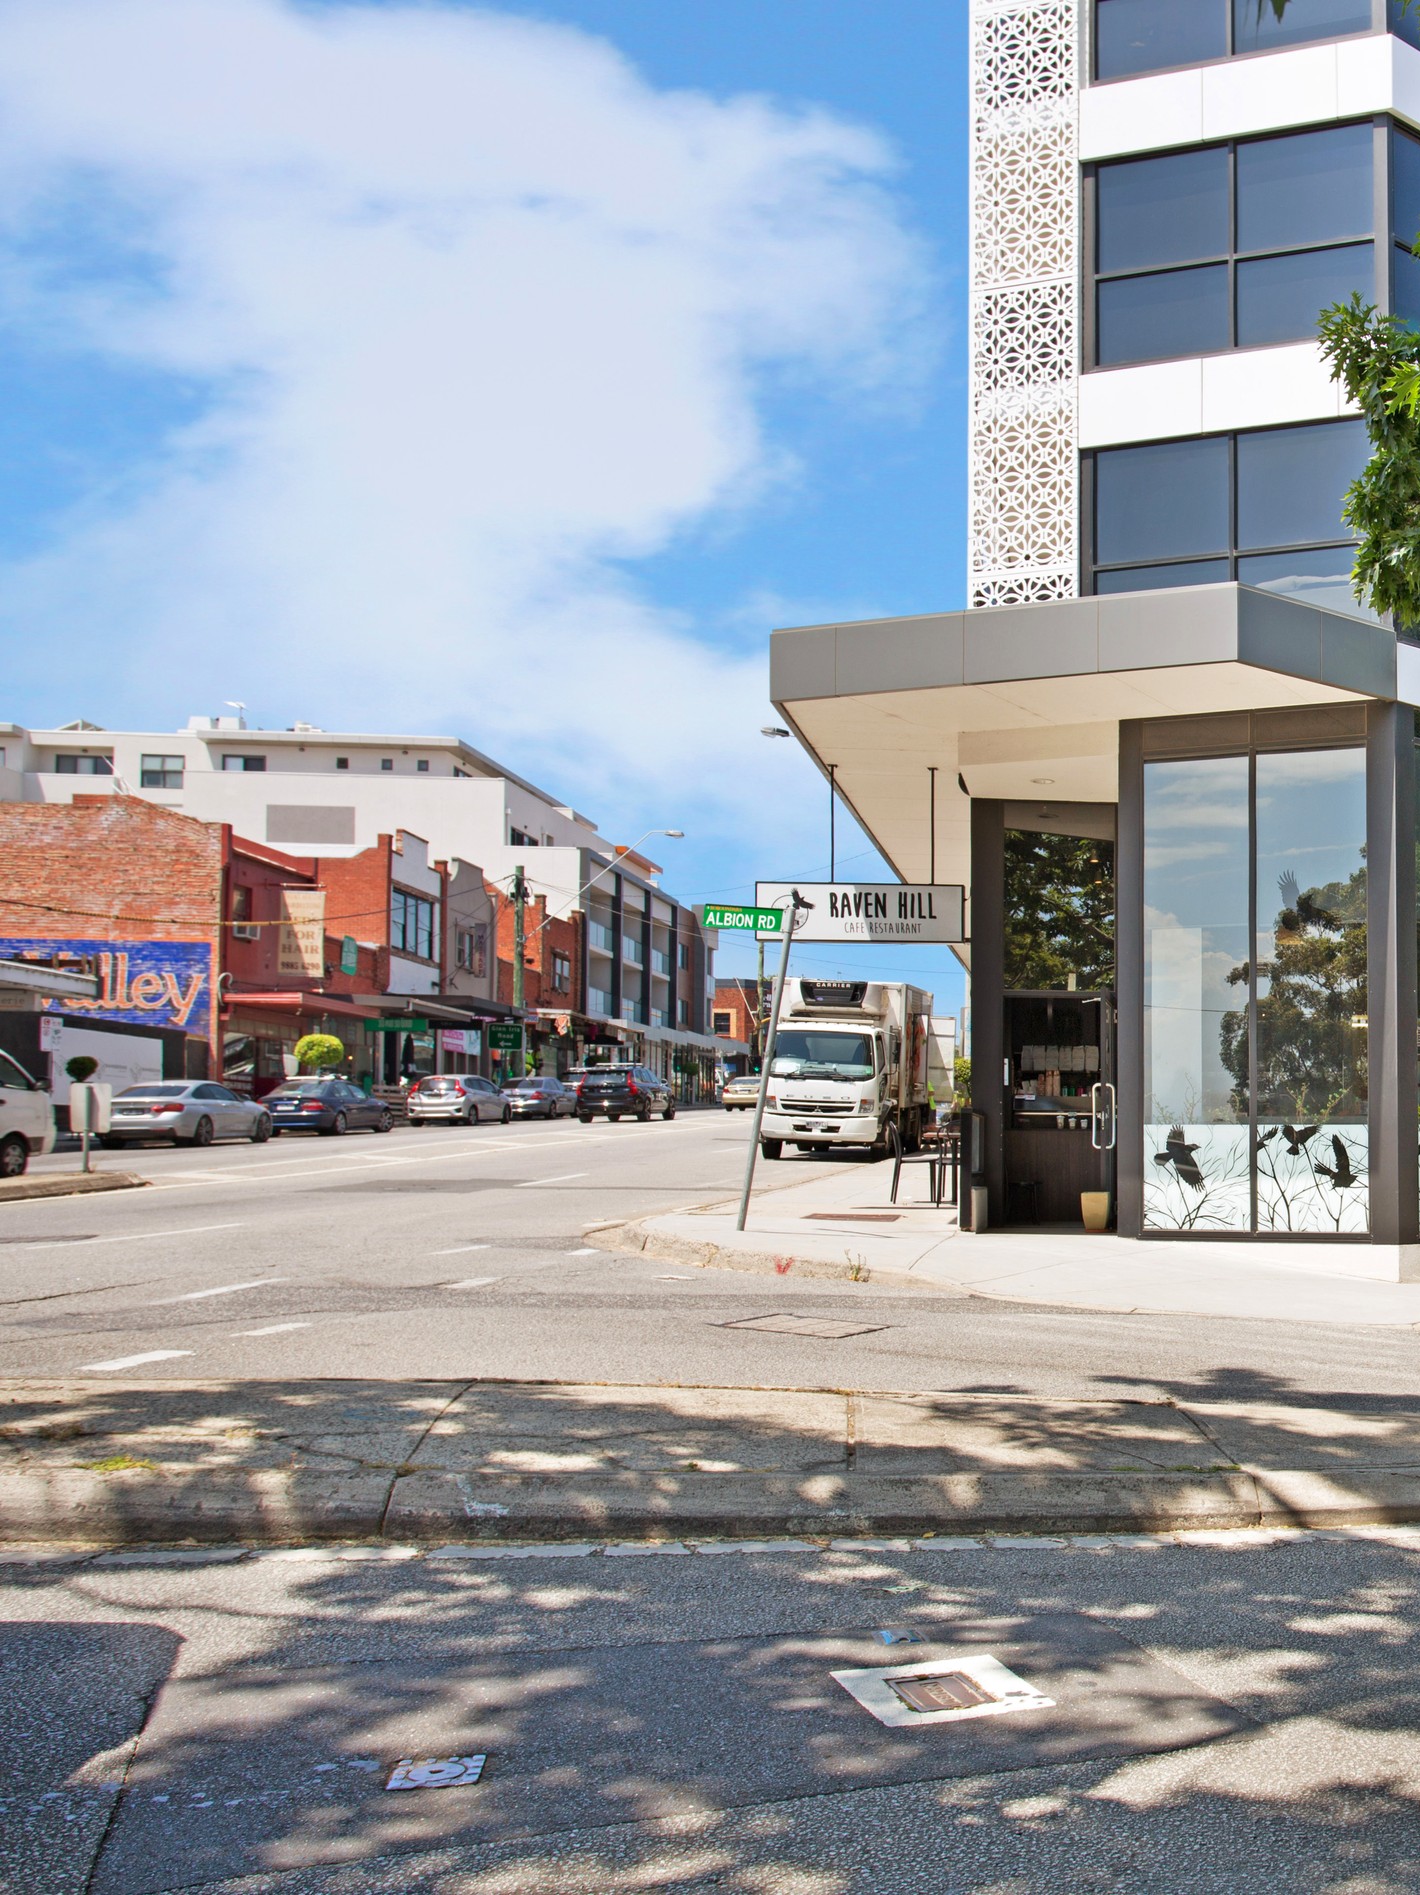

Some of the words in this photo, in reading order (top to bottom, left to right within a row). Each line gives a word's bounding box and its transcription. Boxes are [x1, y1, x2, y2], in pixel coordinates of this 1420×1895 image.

[829, 892, 887, 918] RAVEN
[898, 891, 938, 920] HILL
[706, 912, 754, 928] ALBION
[757, 914, 776, 929] RD
[844, 922, 865, 934] CAFE
[869, 922, 922, 934] RESTAURANT
[287, 930, 315, 940] FOR
[281, 944, 320, 954] HAIR
